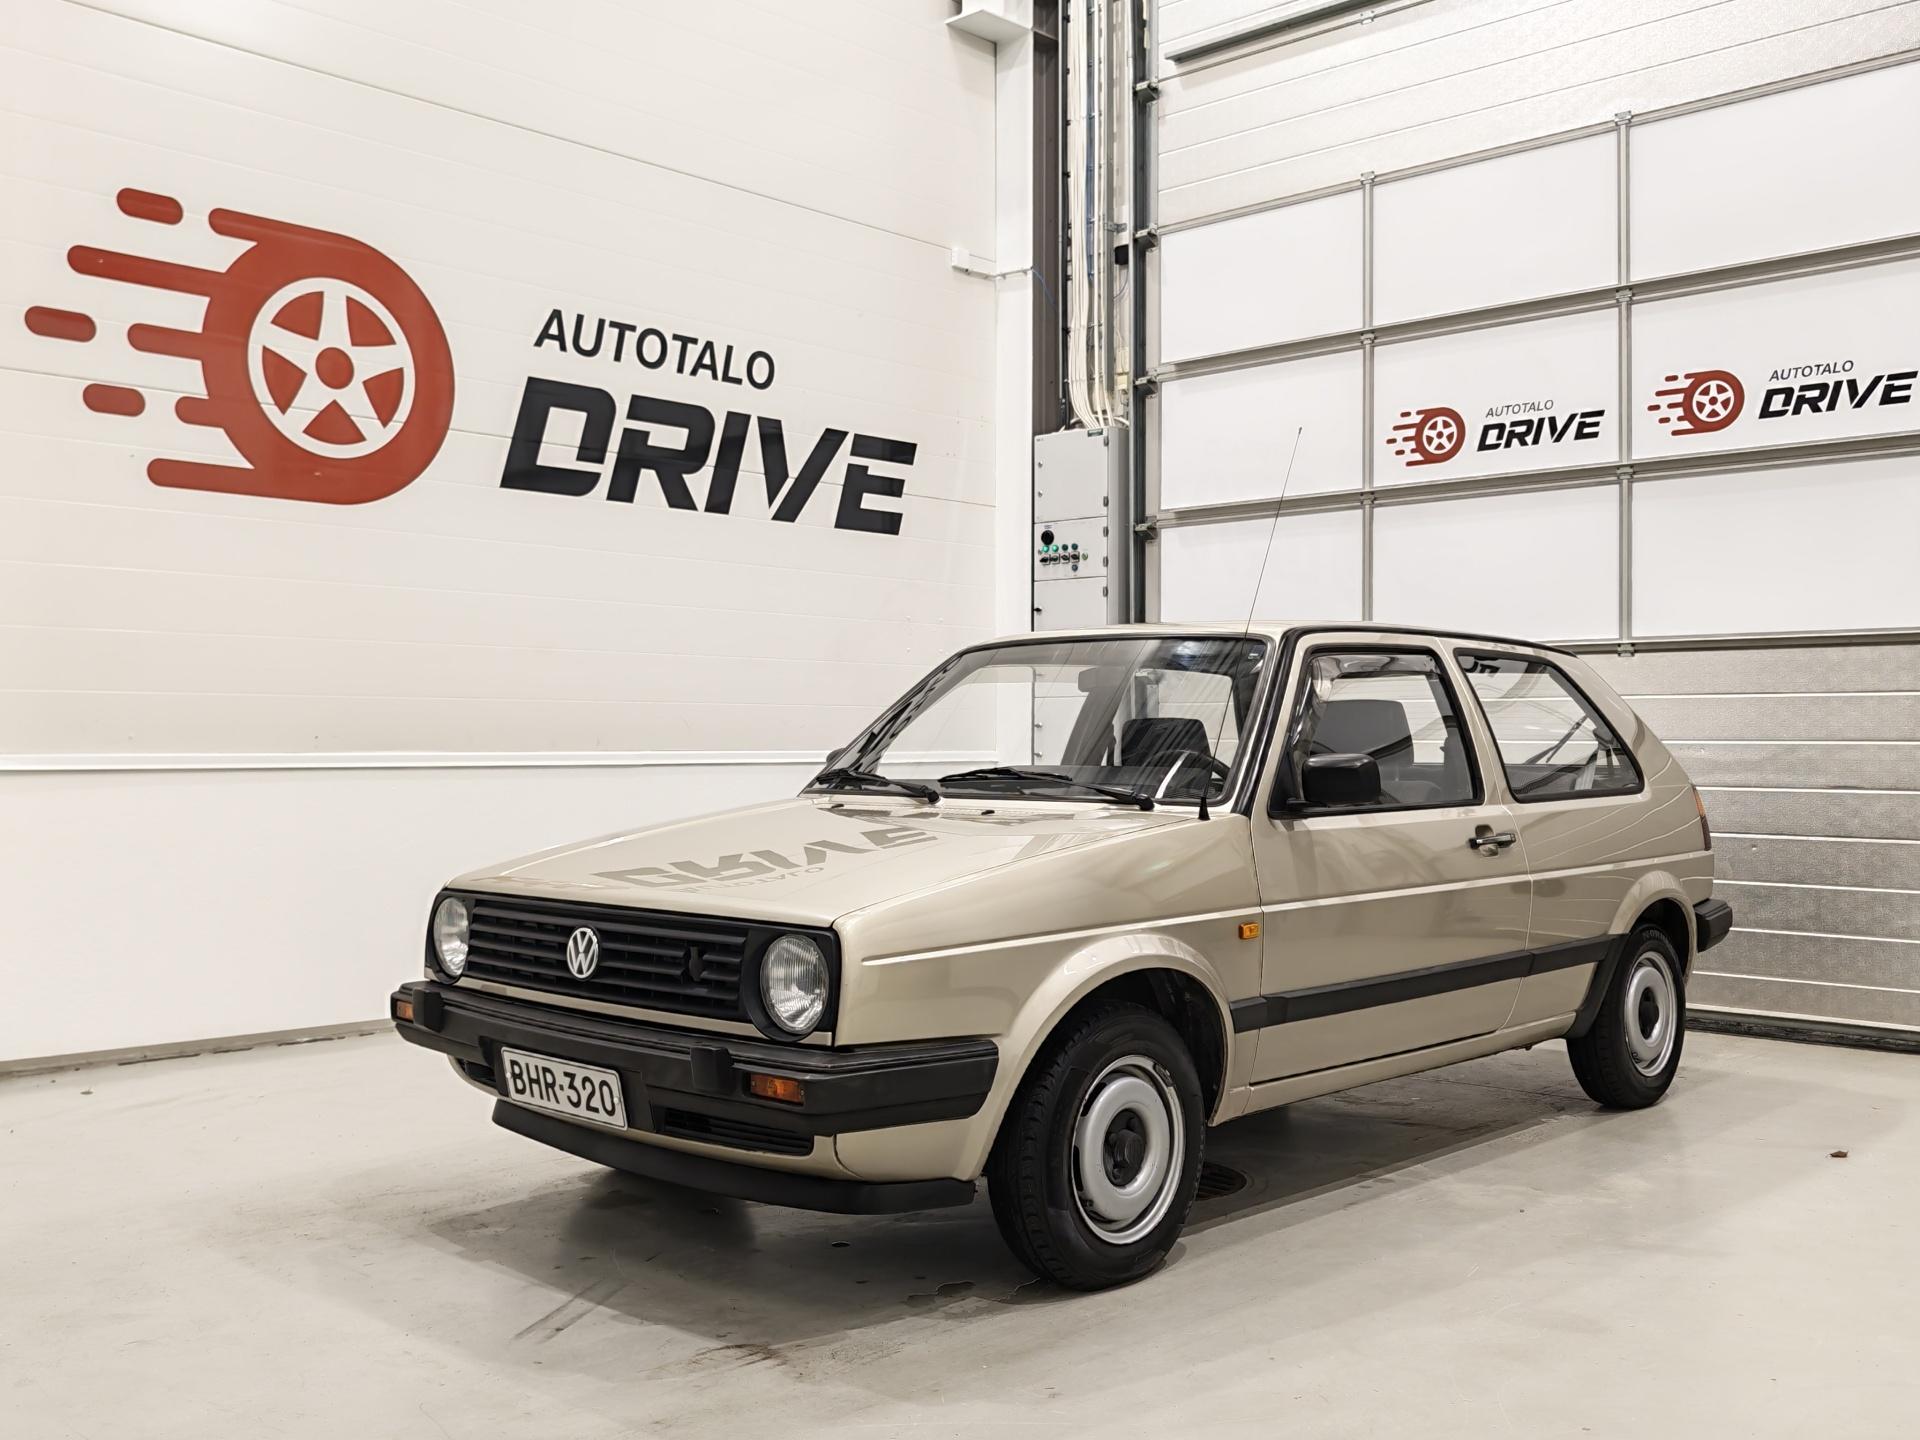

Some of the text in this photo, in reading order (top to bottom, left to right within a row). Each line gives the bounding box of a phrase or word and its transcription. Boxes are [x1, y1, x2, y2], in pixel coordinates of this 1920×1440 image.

[534, 308, 775, 390] AUTOTALO
[1769, 359, 1854, 382] AUTOTALO
[1485, 400, 1553, 418] AUTOTALO
[1759, 371, 1919, 420] DRIVE
[500, 376, 917, 536] DRIVE
[1476, 410, 1605, 452] DRIVE
[566, 926, 600, 980] VW
[509, 1058, 617, 1118] BHR-320
